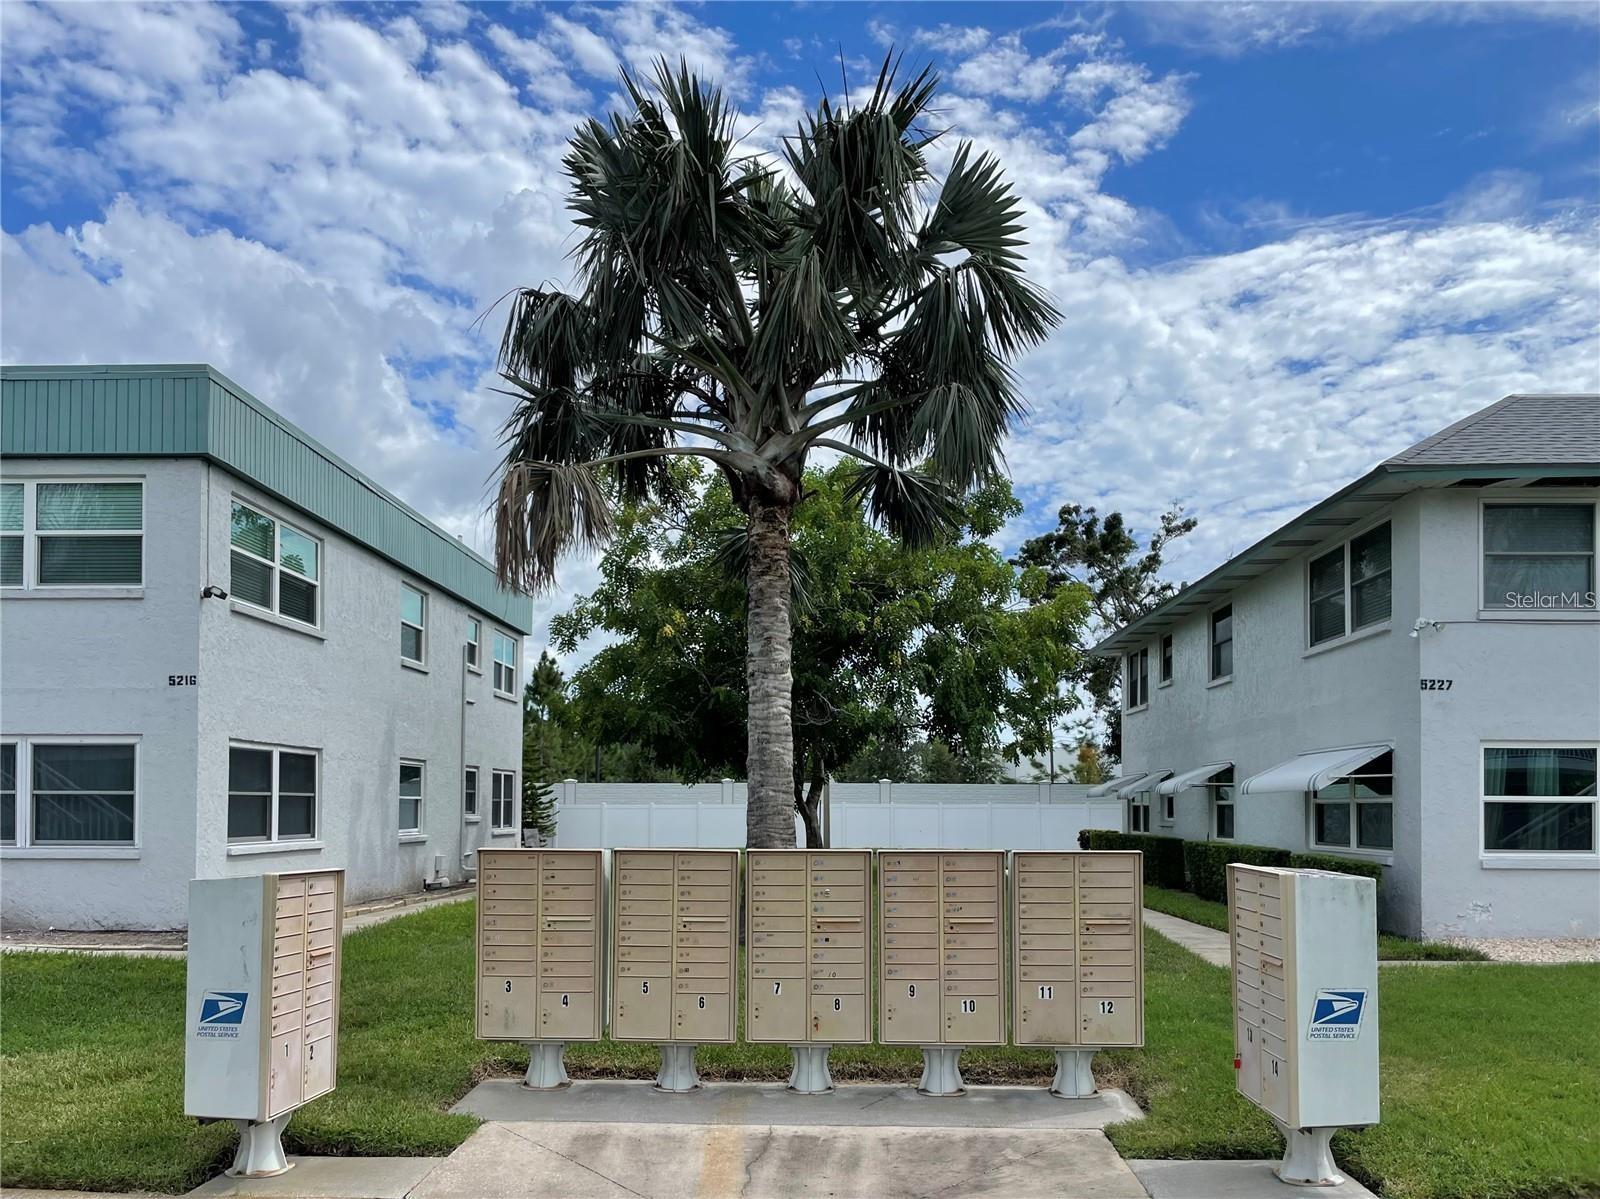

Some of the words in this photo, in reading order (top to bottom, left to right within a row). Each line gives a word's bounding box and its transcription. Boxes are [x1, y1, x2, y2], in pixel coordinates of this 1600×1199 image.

[168, 675, 197, 686] 5216
[1420, 679, 1453, 690] 5227
[505, 981, 512, 993] 3
[642, 982, 649, 994] 5
[774, 982, 781, 994] 7
[909, 985, 916, 998] 9
[1039, 986, 1052, 999] 11
[562, 995, 569, 1007] 4
[698, 997, 705, 1009] 6
[834, 999, 841, 1011] 8
[962, 1000, 976, 1013] 10
[1100, 1001, 1114, 1014] 12
[309, 1045, 314, 1060] 2
[1271, 1060, 1279, 1077] 14
